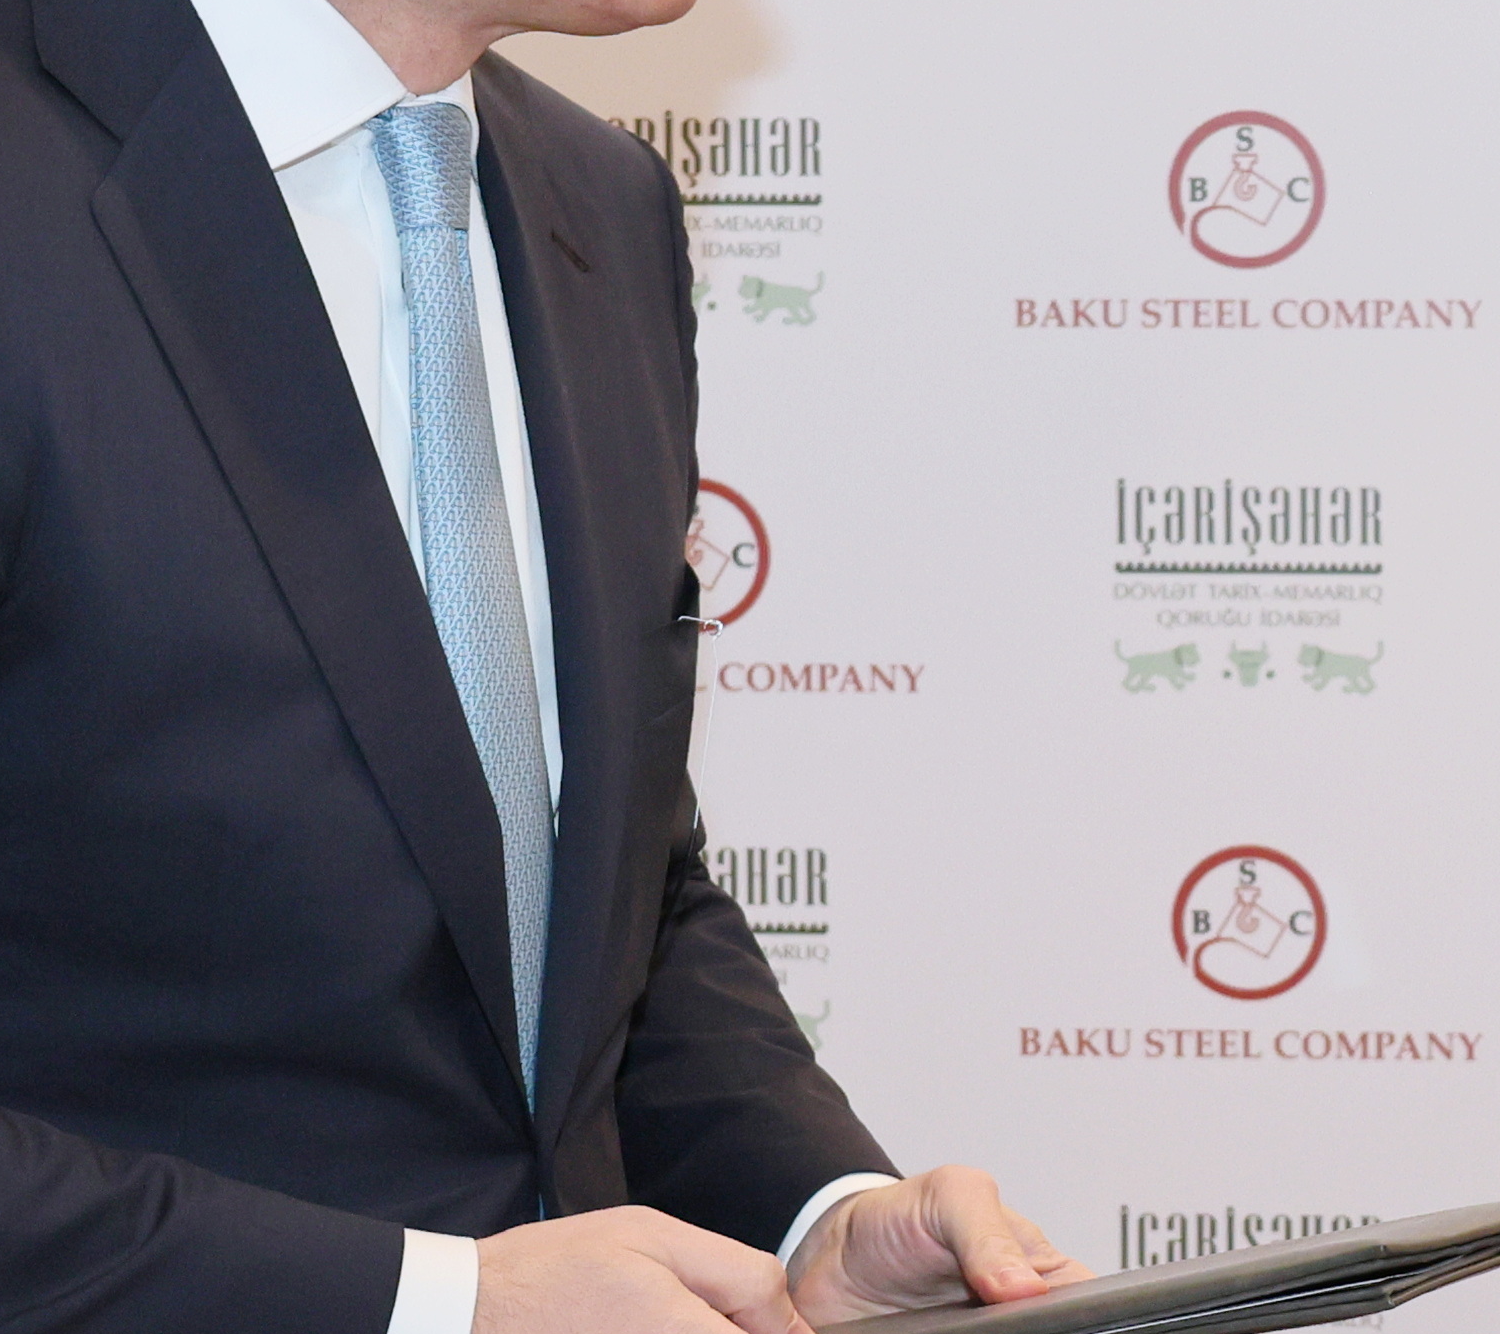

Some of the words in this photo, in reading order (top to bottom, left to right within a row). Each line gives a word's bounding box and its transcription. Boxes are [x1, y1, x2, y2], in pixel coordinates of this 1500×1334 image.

[1236, 127, 1253, 152] S
[1190, 178, 1207, 202] B
[1287, 177, 1309, 202] C
[1015, 298, 1128, 329] BAKU
[1141, 298, 1259, 328] STEEL
[1271, 299, 1481, 329] COMPANY
[719, 663, 925, 694] COMPANY
[1240, 860, 1256, 885] S
[1193, 911, 1210, 934] B
[1289, 911, 1310, 935] C
[1020, 1027, 1131, 1059] BAKU
[1144, 1029, 1261, 1059] STEEL
[1273, 1030, 1482, 1062] COMPANY
